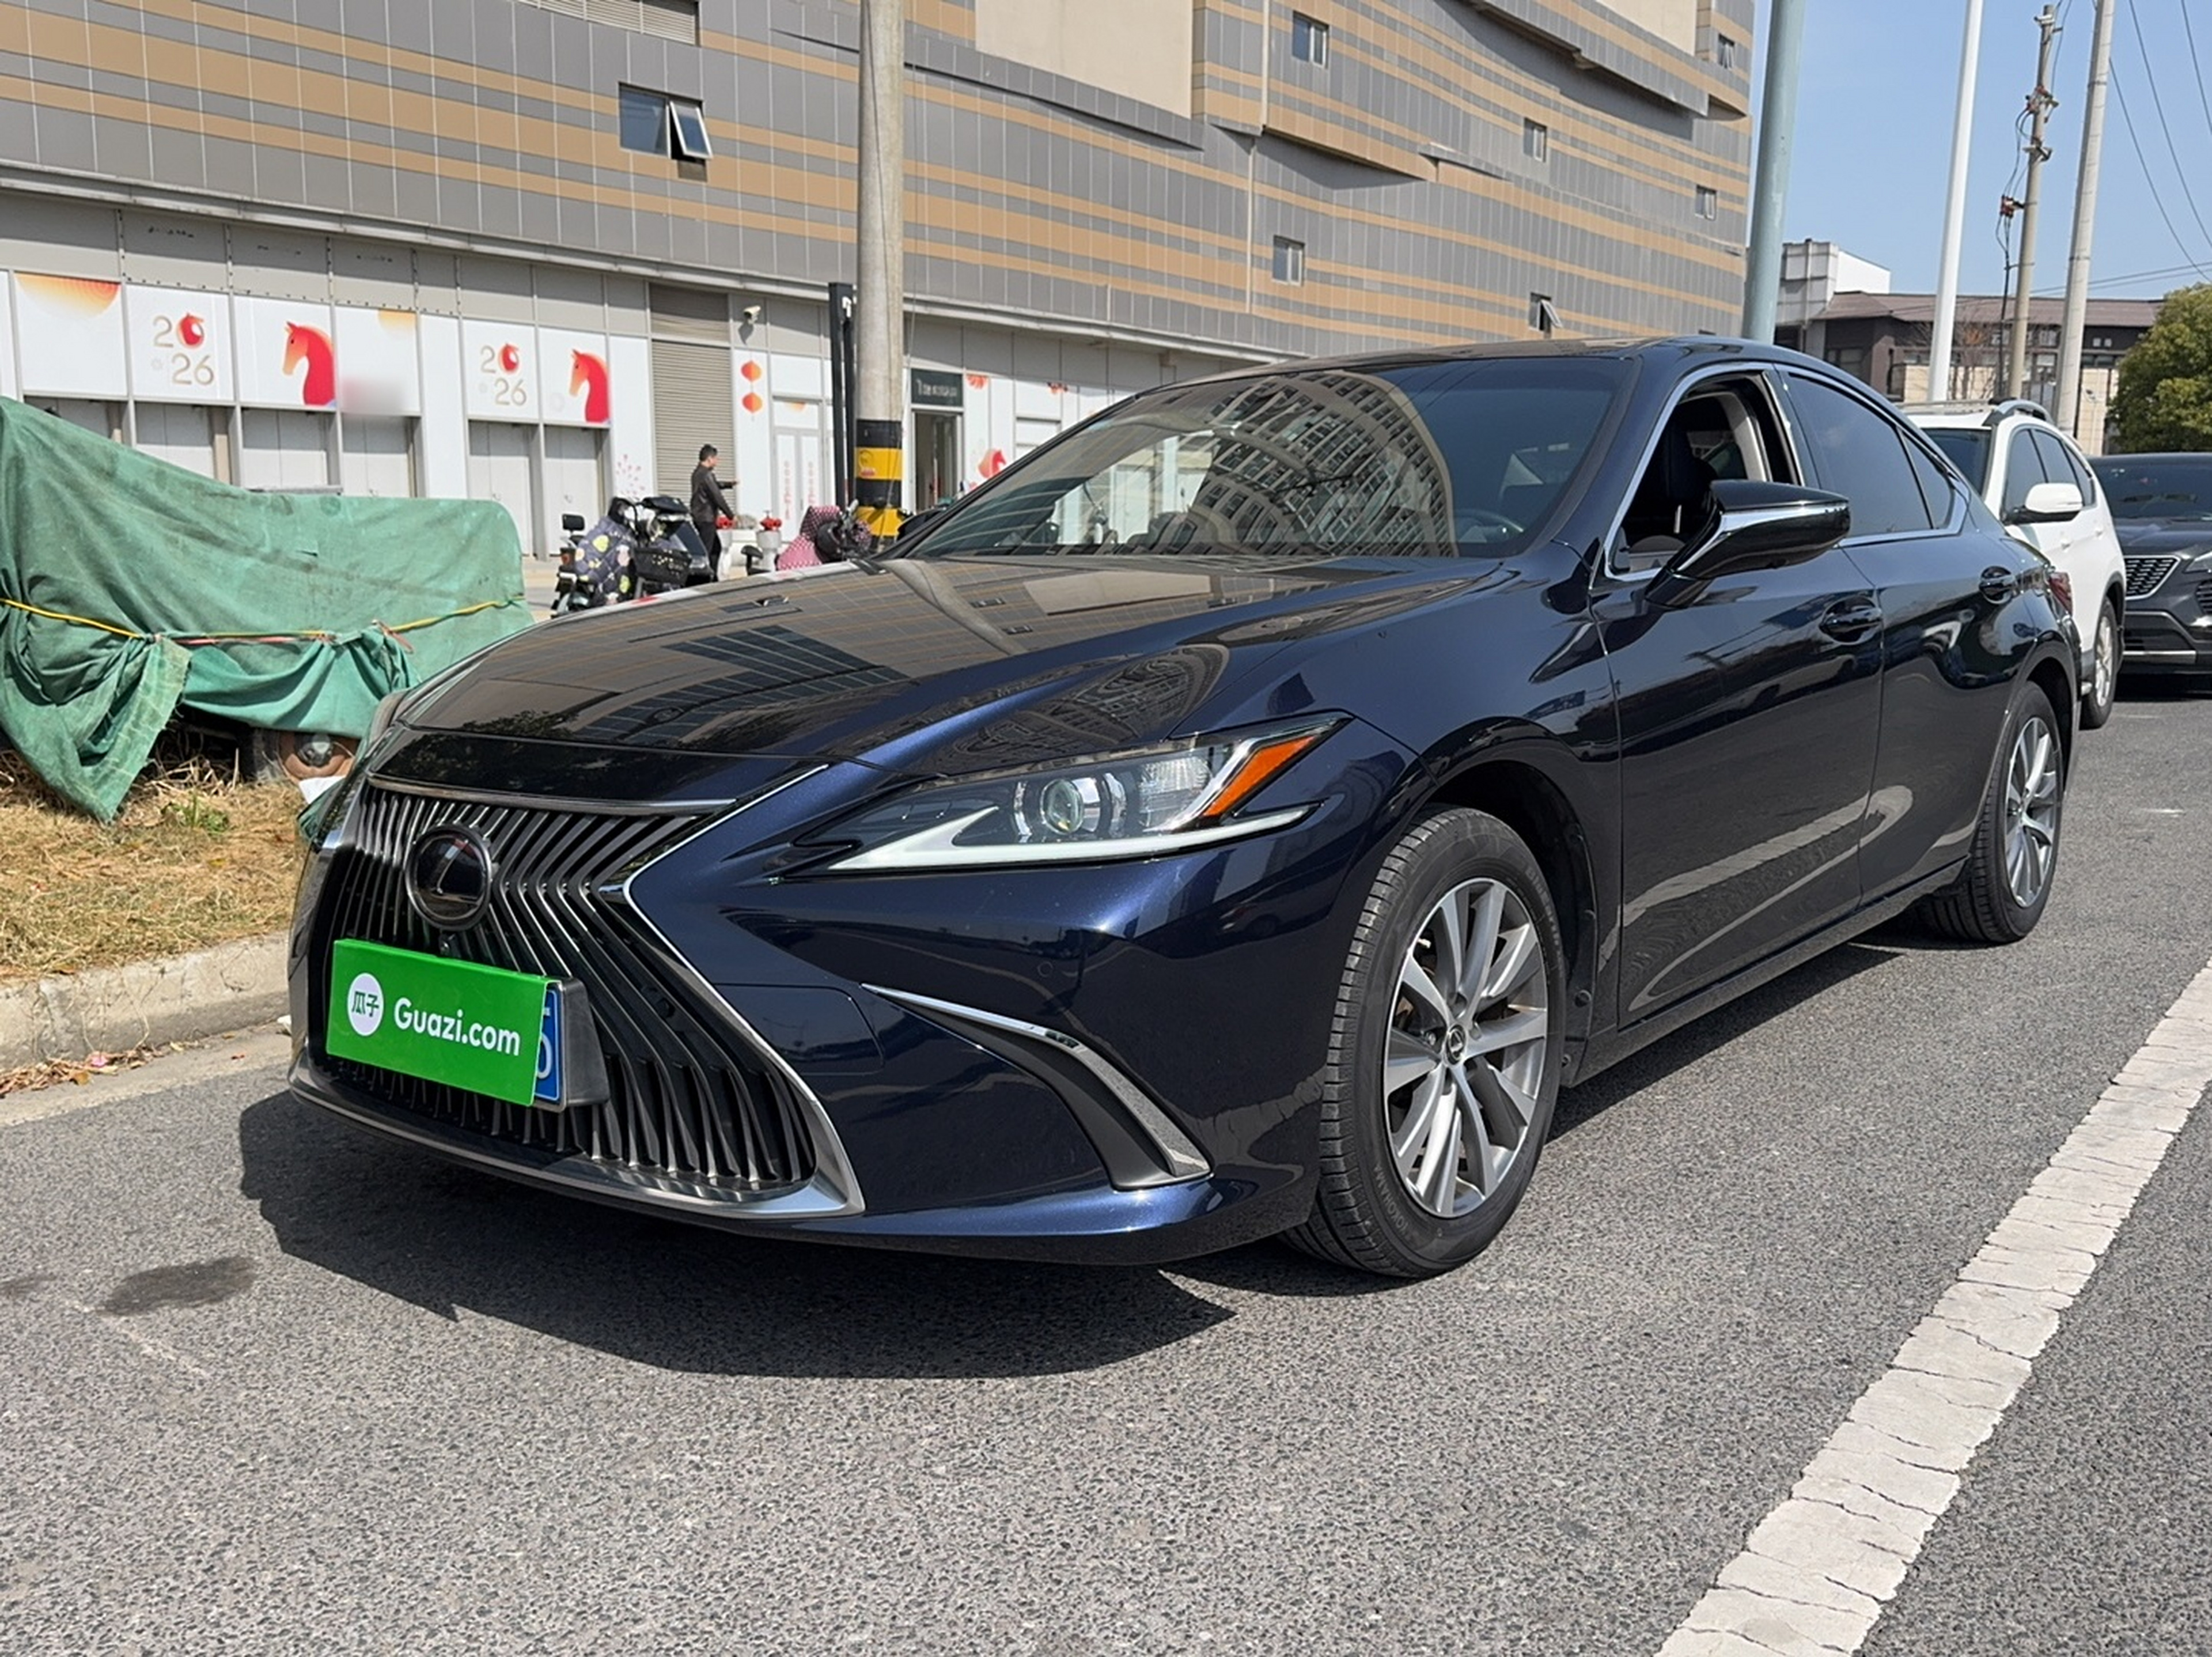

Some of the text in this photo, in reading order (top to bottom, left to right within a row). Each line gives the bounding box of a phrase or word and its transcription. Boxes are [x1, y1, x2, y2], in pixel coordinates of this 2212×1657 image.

[172, 353, 214, 385] 26
[494, 377, 527, 406] 26
[352, 991, 380, 1017] 瓜子
[394, 997, 520, 1056] Guazi.com
[1373, 1162, 1409, 1235] YOKOHAMA
